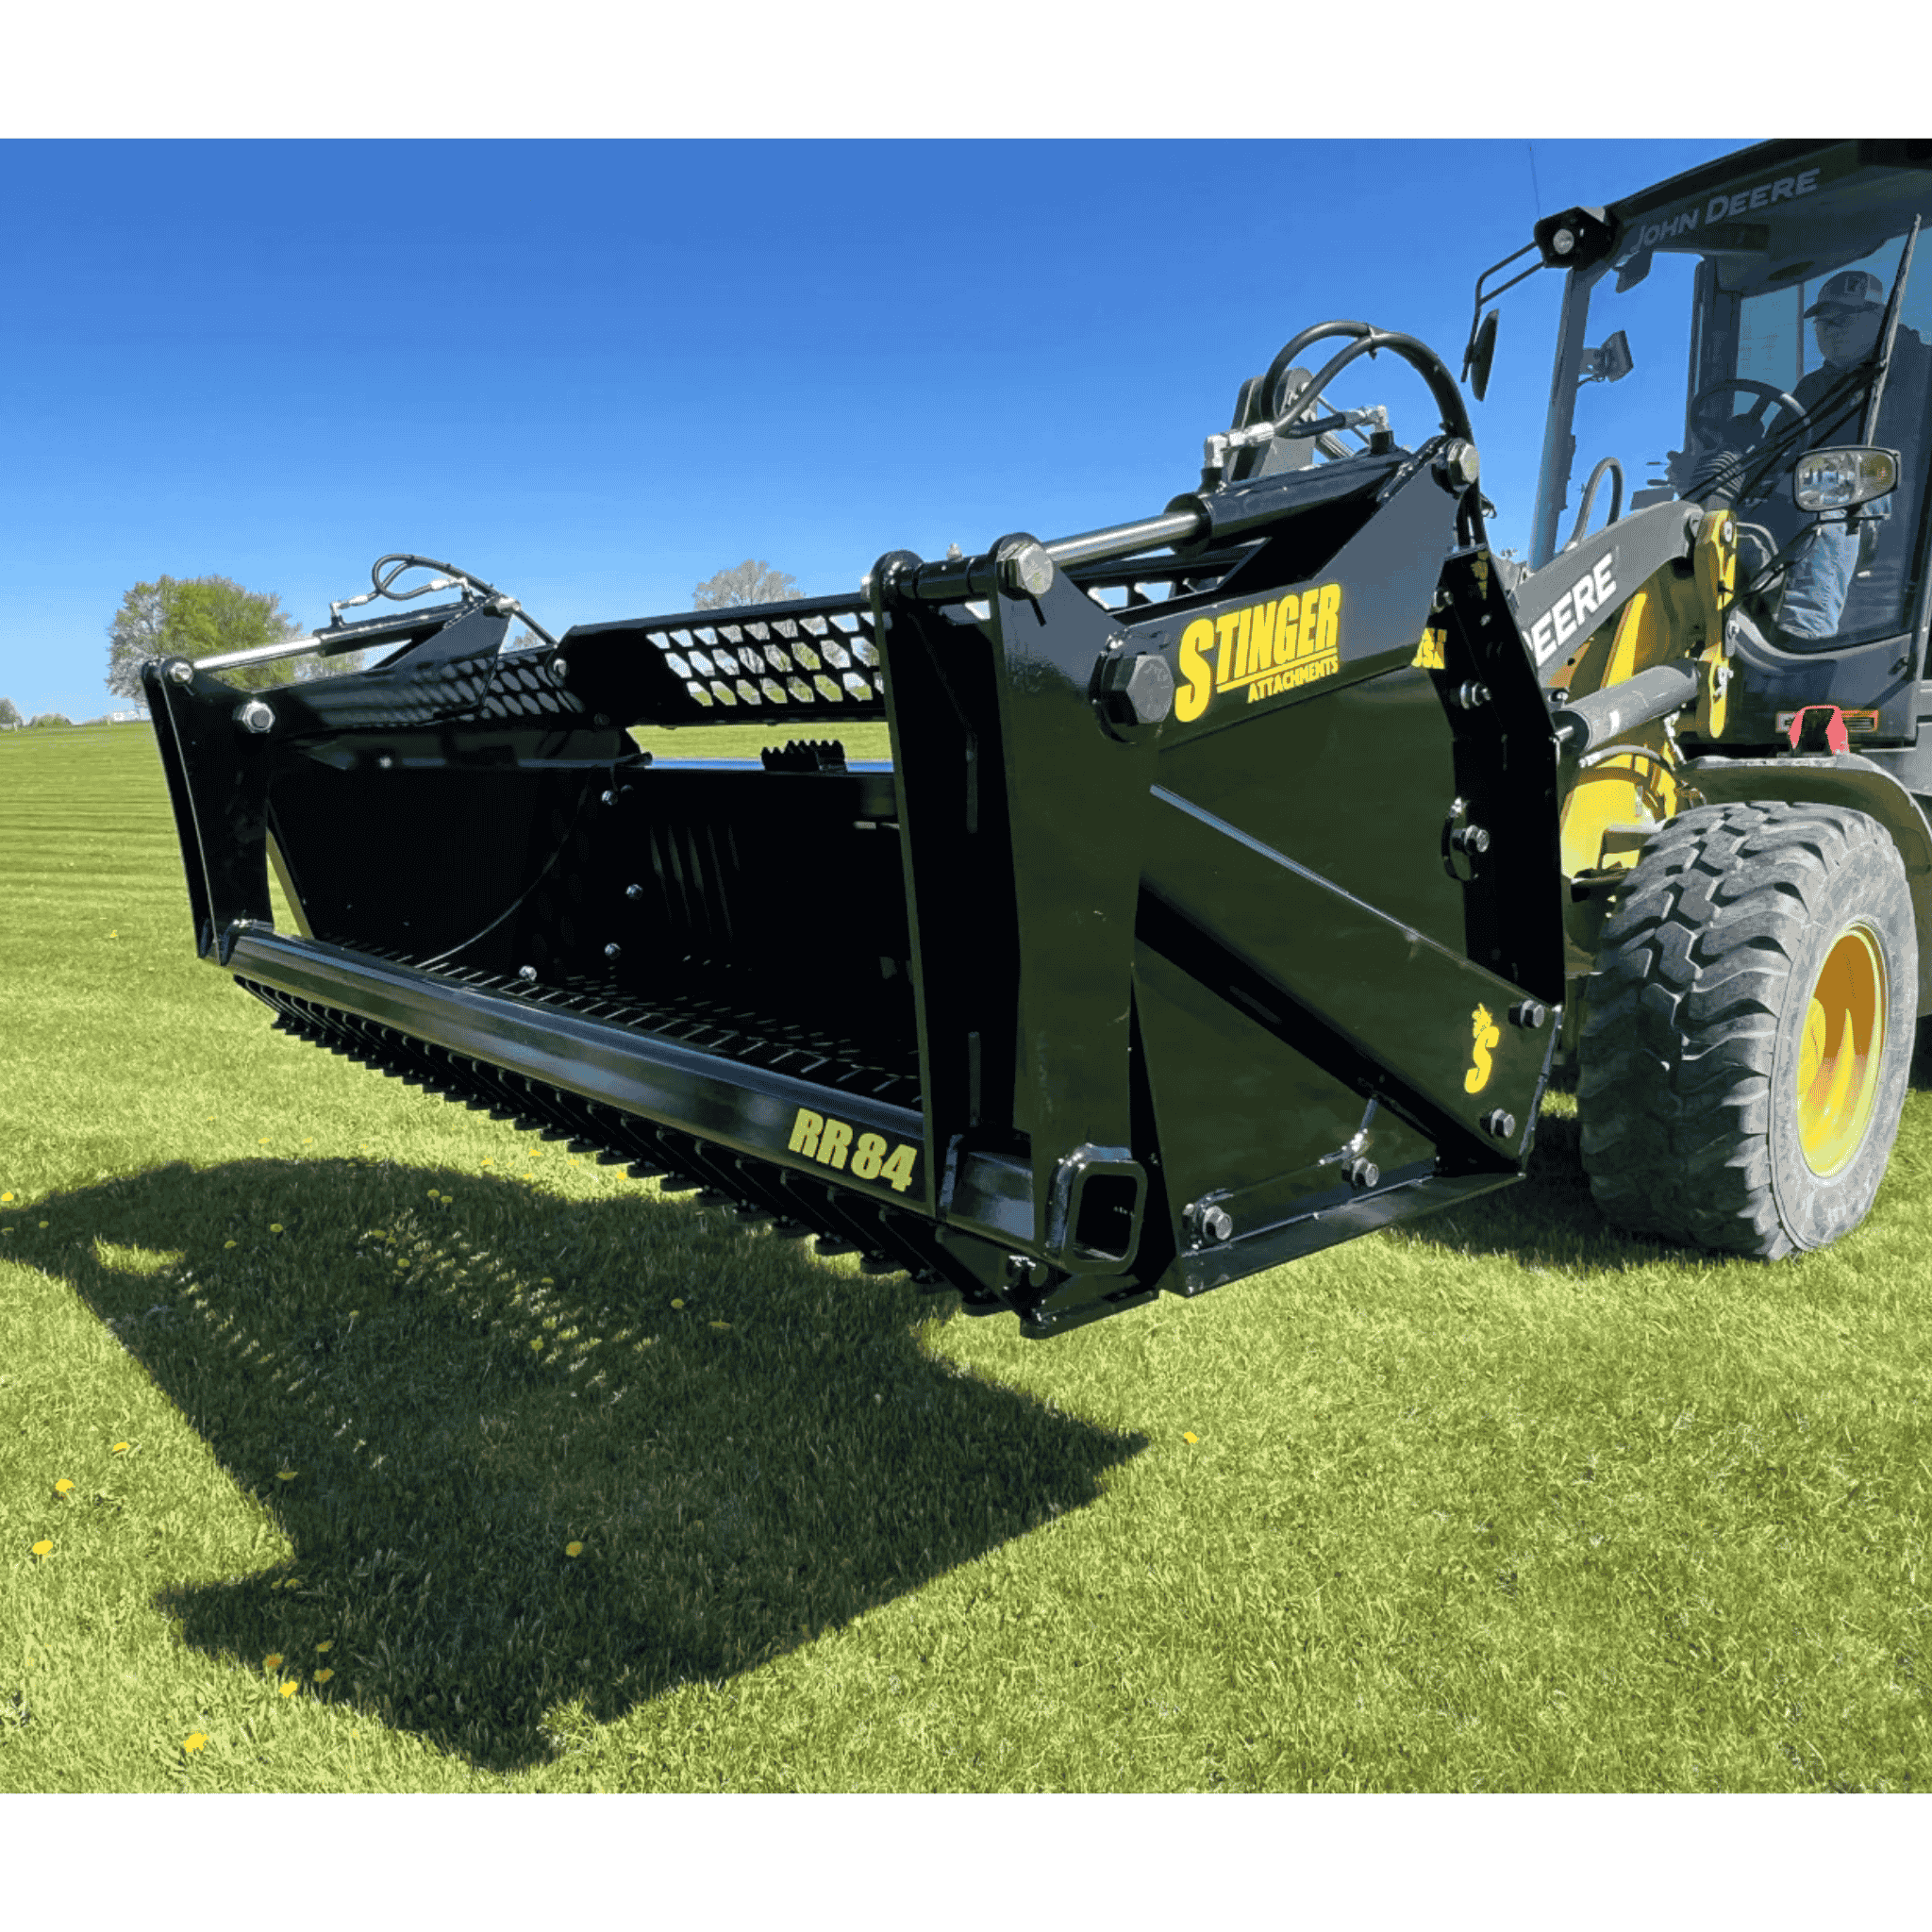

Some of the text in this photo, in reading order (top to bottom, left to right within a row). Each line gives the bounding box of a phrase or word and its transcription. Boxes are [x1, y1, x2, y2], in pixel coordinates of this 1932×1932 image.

[1630, 168, 1821, 254] JOHN DEERE
[1174, 583, 1341, 723] STINGER
[1521, 553, 1617, 667] EERE
[1247, 656, 1339, 704] ATTACHMENTS
